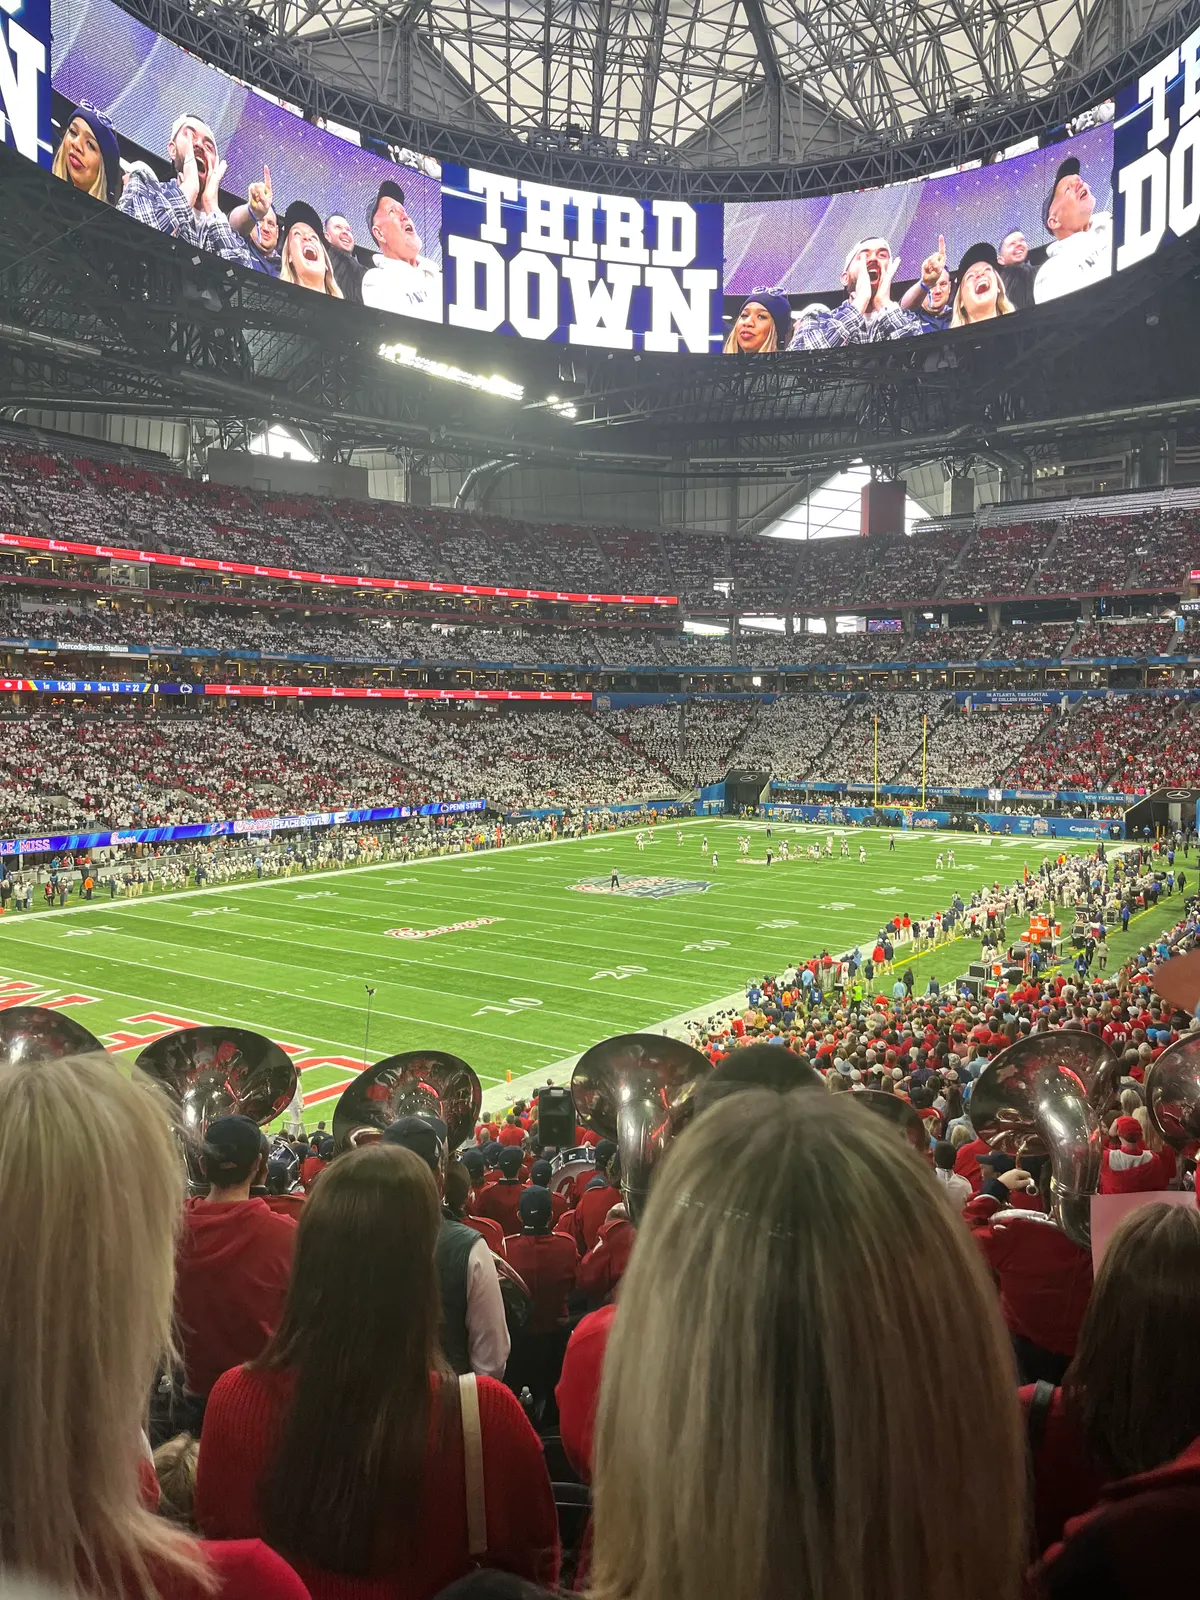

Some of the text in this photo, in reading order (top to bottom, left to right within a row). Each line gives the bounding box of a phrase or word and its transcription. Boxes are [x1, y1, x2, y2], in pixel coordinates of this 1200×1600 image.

[468, 167, 697, 267] THIRD
[448, 234, 718, 353] DOWN
[58, 641, 128, 652] Mercedes-Benz Stadium
[17, 681, 23, 690] 0
[57, 682, 76, 691] 14:30
[84, 683, 91, 691] 26
[112, 683, 119, 692] 13
[132, 684, 140, 692] 22
[154, 683, 159, 692] 0
[989, 789, 1002, 800] 26
[449, 801, 482, 811] PENN STATE
[274, 819, 299, 829] PEACH
[300, 817, 324, 826] BOWL
[715, 823, 1079, 850] PENN STATE
[20, 839, 50, 853] MISS
[685, 939, 732, 952] 30
[594, 964, 649, 980] 20
[478, 997, 544, 1016] 10
